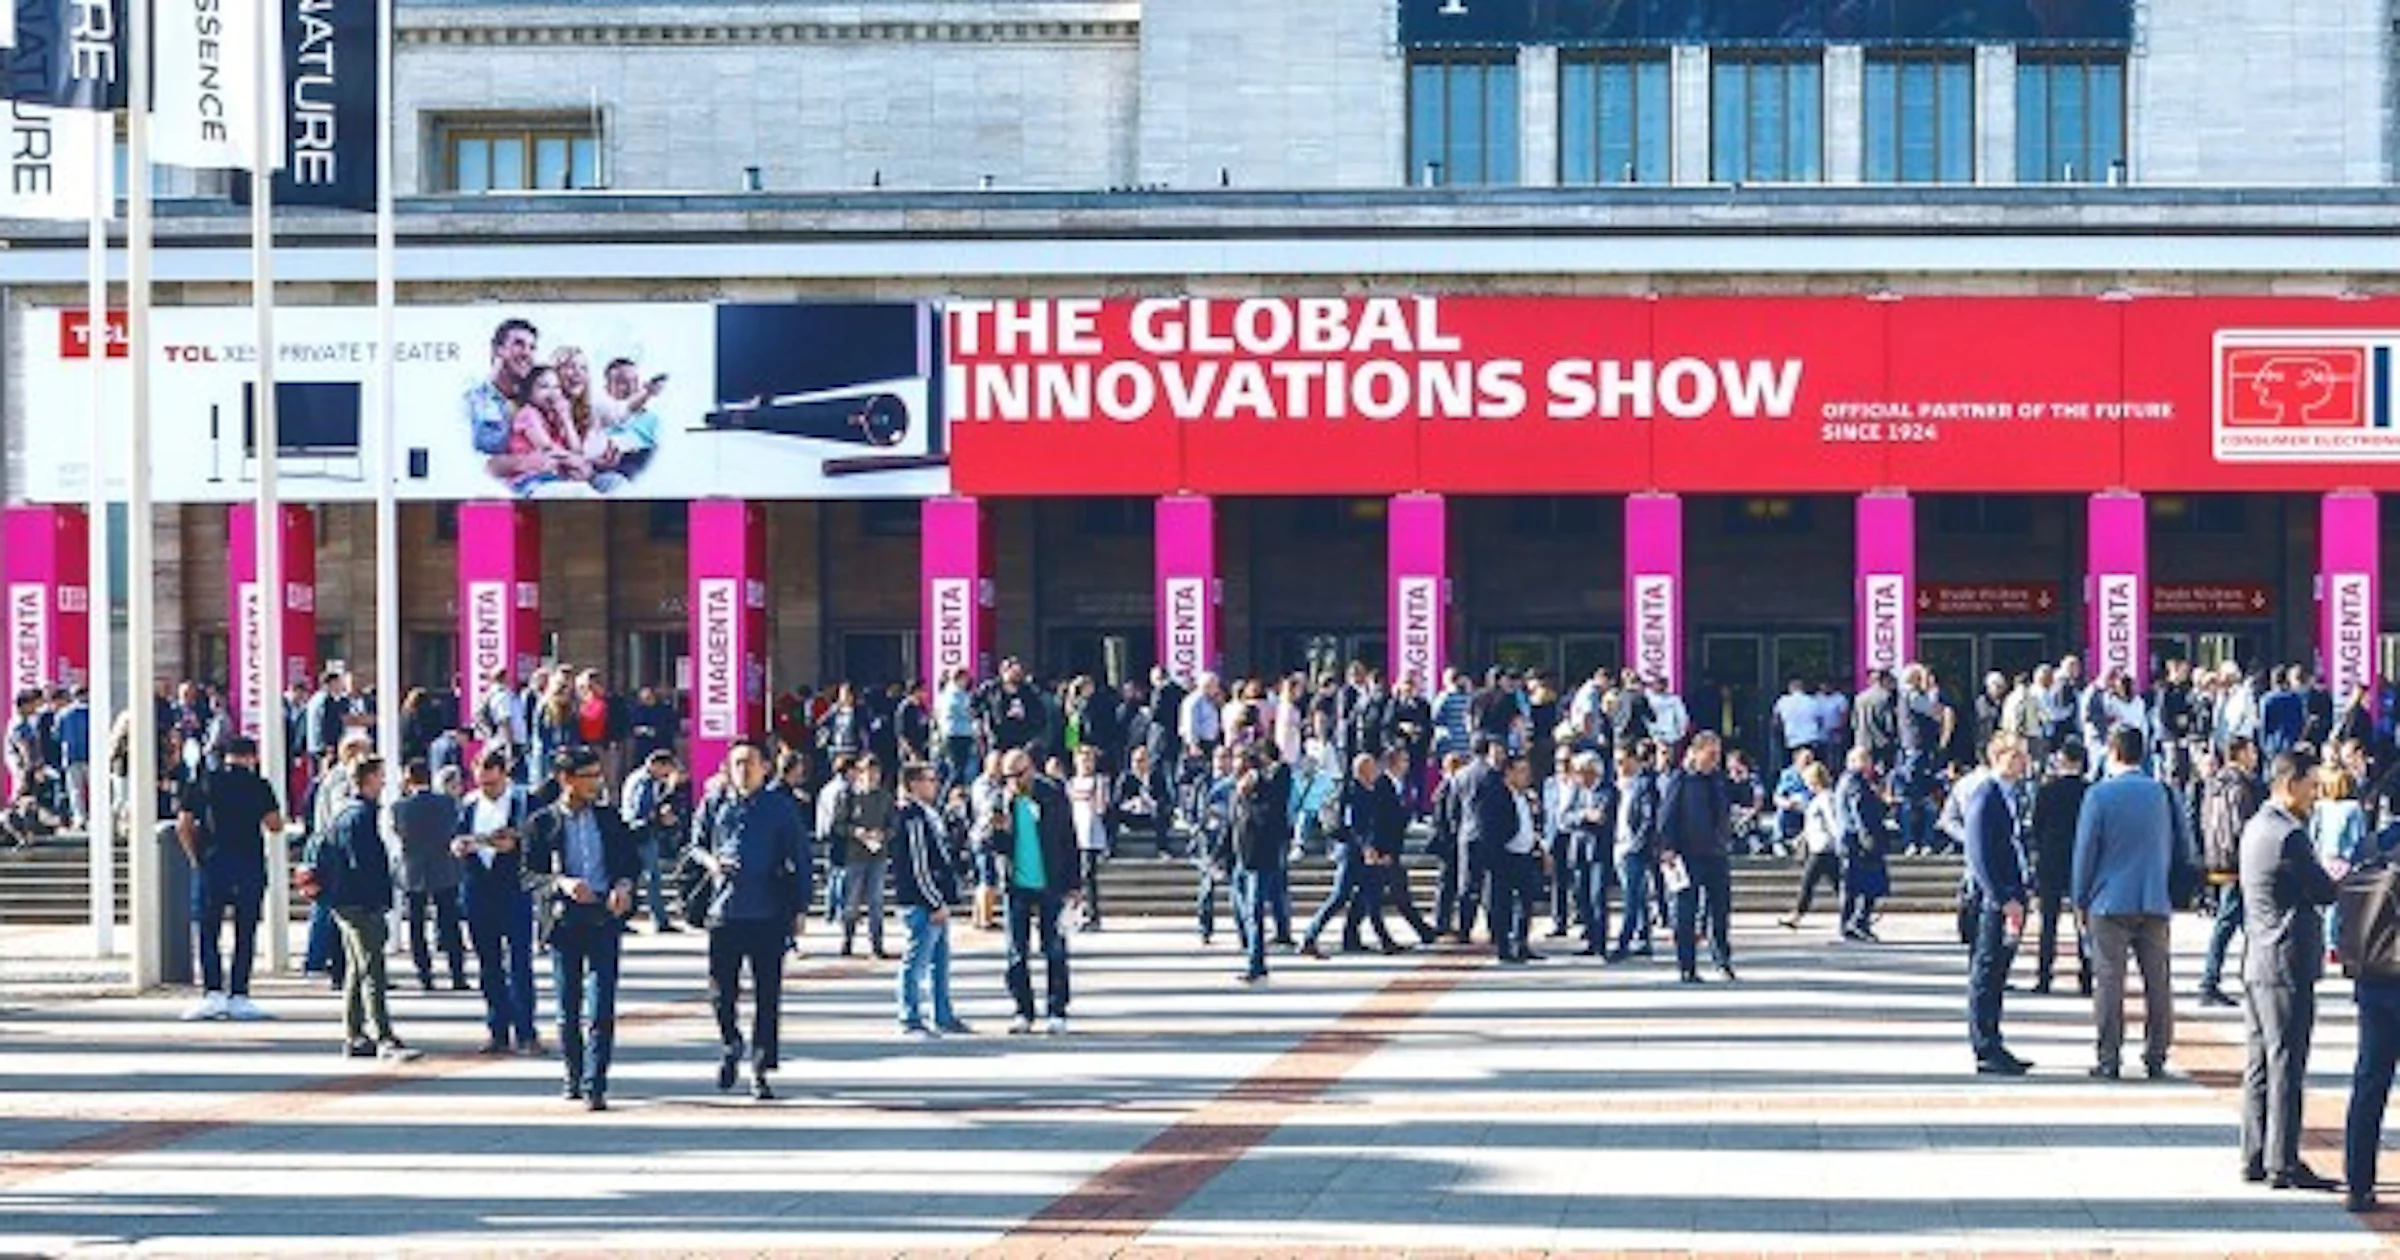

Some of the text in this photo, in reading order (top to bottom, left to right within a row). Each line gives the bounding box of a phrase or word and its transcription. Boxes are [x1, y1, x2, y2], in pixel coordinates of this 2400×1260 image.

[163, 345, 218, 362] TCL
[279, 342, 362, 362] PRIVATE
[366, 342, 460, 362] TEATER
[948, 296, 1461, 356] THE GLOBAL
[946, 357, 1802, 421] INNOVATIONS SHOW
[1821, 403, 2175, 419] OFFICIAL PARTNER OF THE FUTURE
[1821, 423, 1938, 441] SINCE 1924
[17, 590, 40, 688] AGENTA
[708, 586, 729, 704] MAGENTA
[1175, 585, 1195, 686] AGENTA
